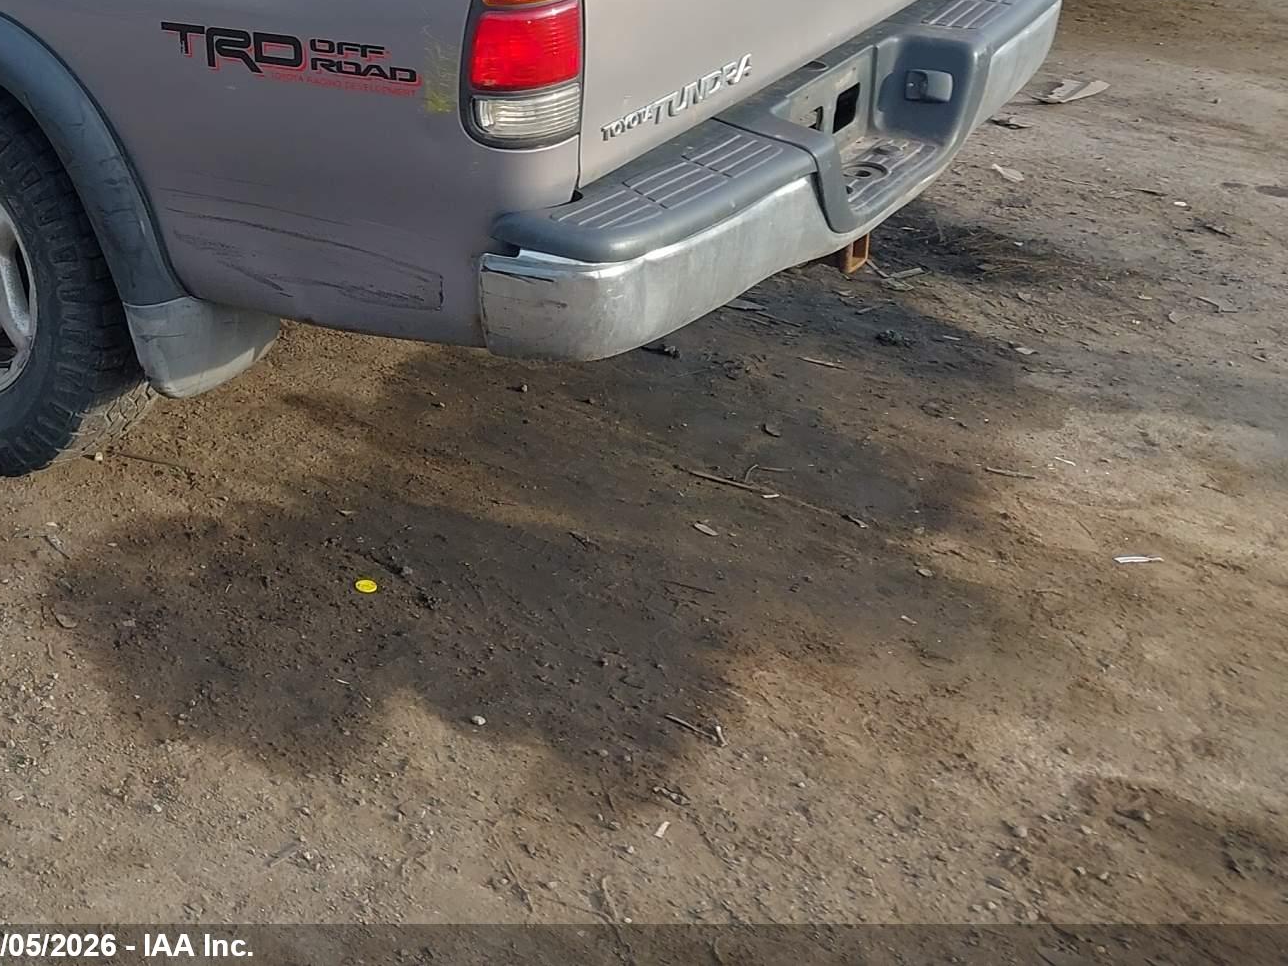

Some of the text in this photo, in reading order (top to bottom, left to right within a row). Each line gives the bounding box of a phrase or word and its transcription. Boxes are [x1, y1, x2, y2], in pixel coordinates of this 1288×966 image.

[161, 22, 306, 76] TRD
[310, 38, 389, 61] OFF
[310, 57, 421, 86] ROAD
[601, 53, 753, 141] TOYOTA TUNDRA
